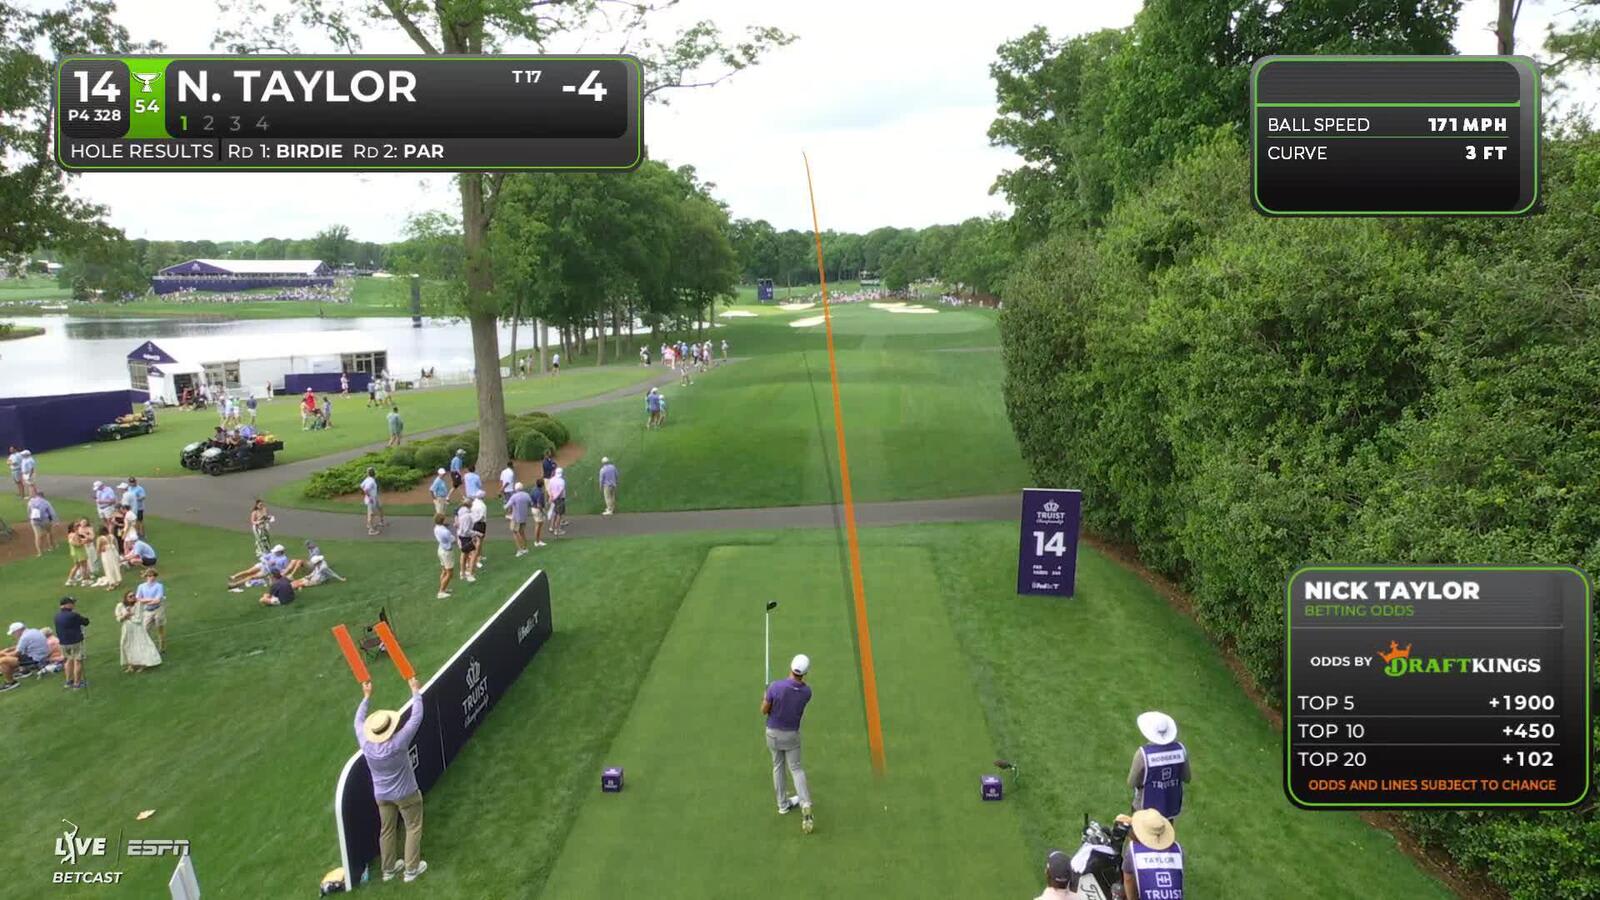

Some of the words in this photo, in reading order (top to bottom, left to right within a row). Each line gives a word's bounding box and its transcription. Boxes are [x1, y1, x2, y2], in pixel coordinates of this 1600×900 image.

[1036, 511, 1065, 519] TRUIST
[1033, 531, 1066, 556] 14
[462, 676, 488, 716] TRUIST
[1151, 779, 1179, 790] TRUIST
[1144, 856, 1175, 864] TAYLOR
